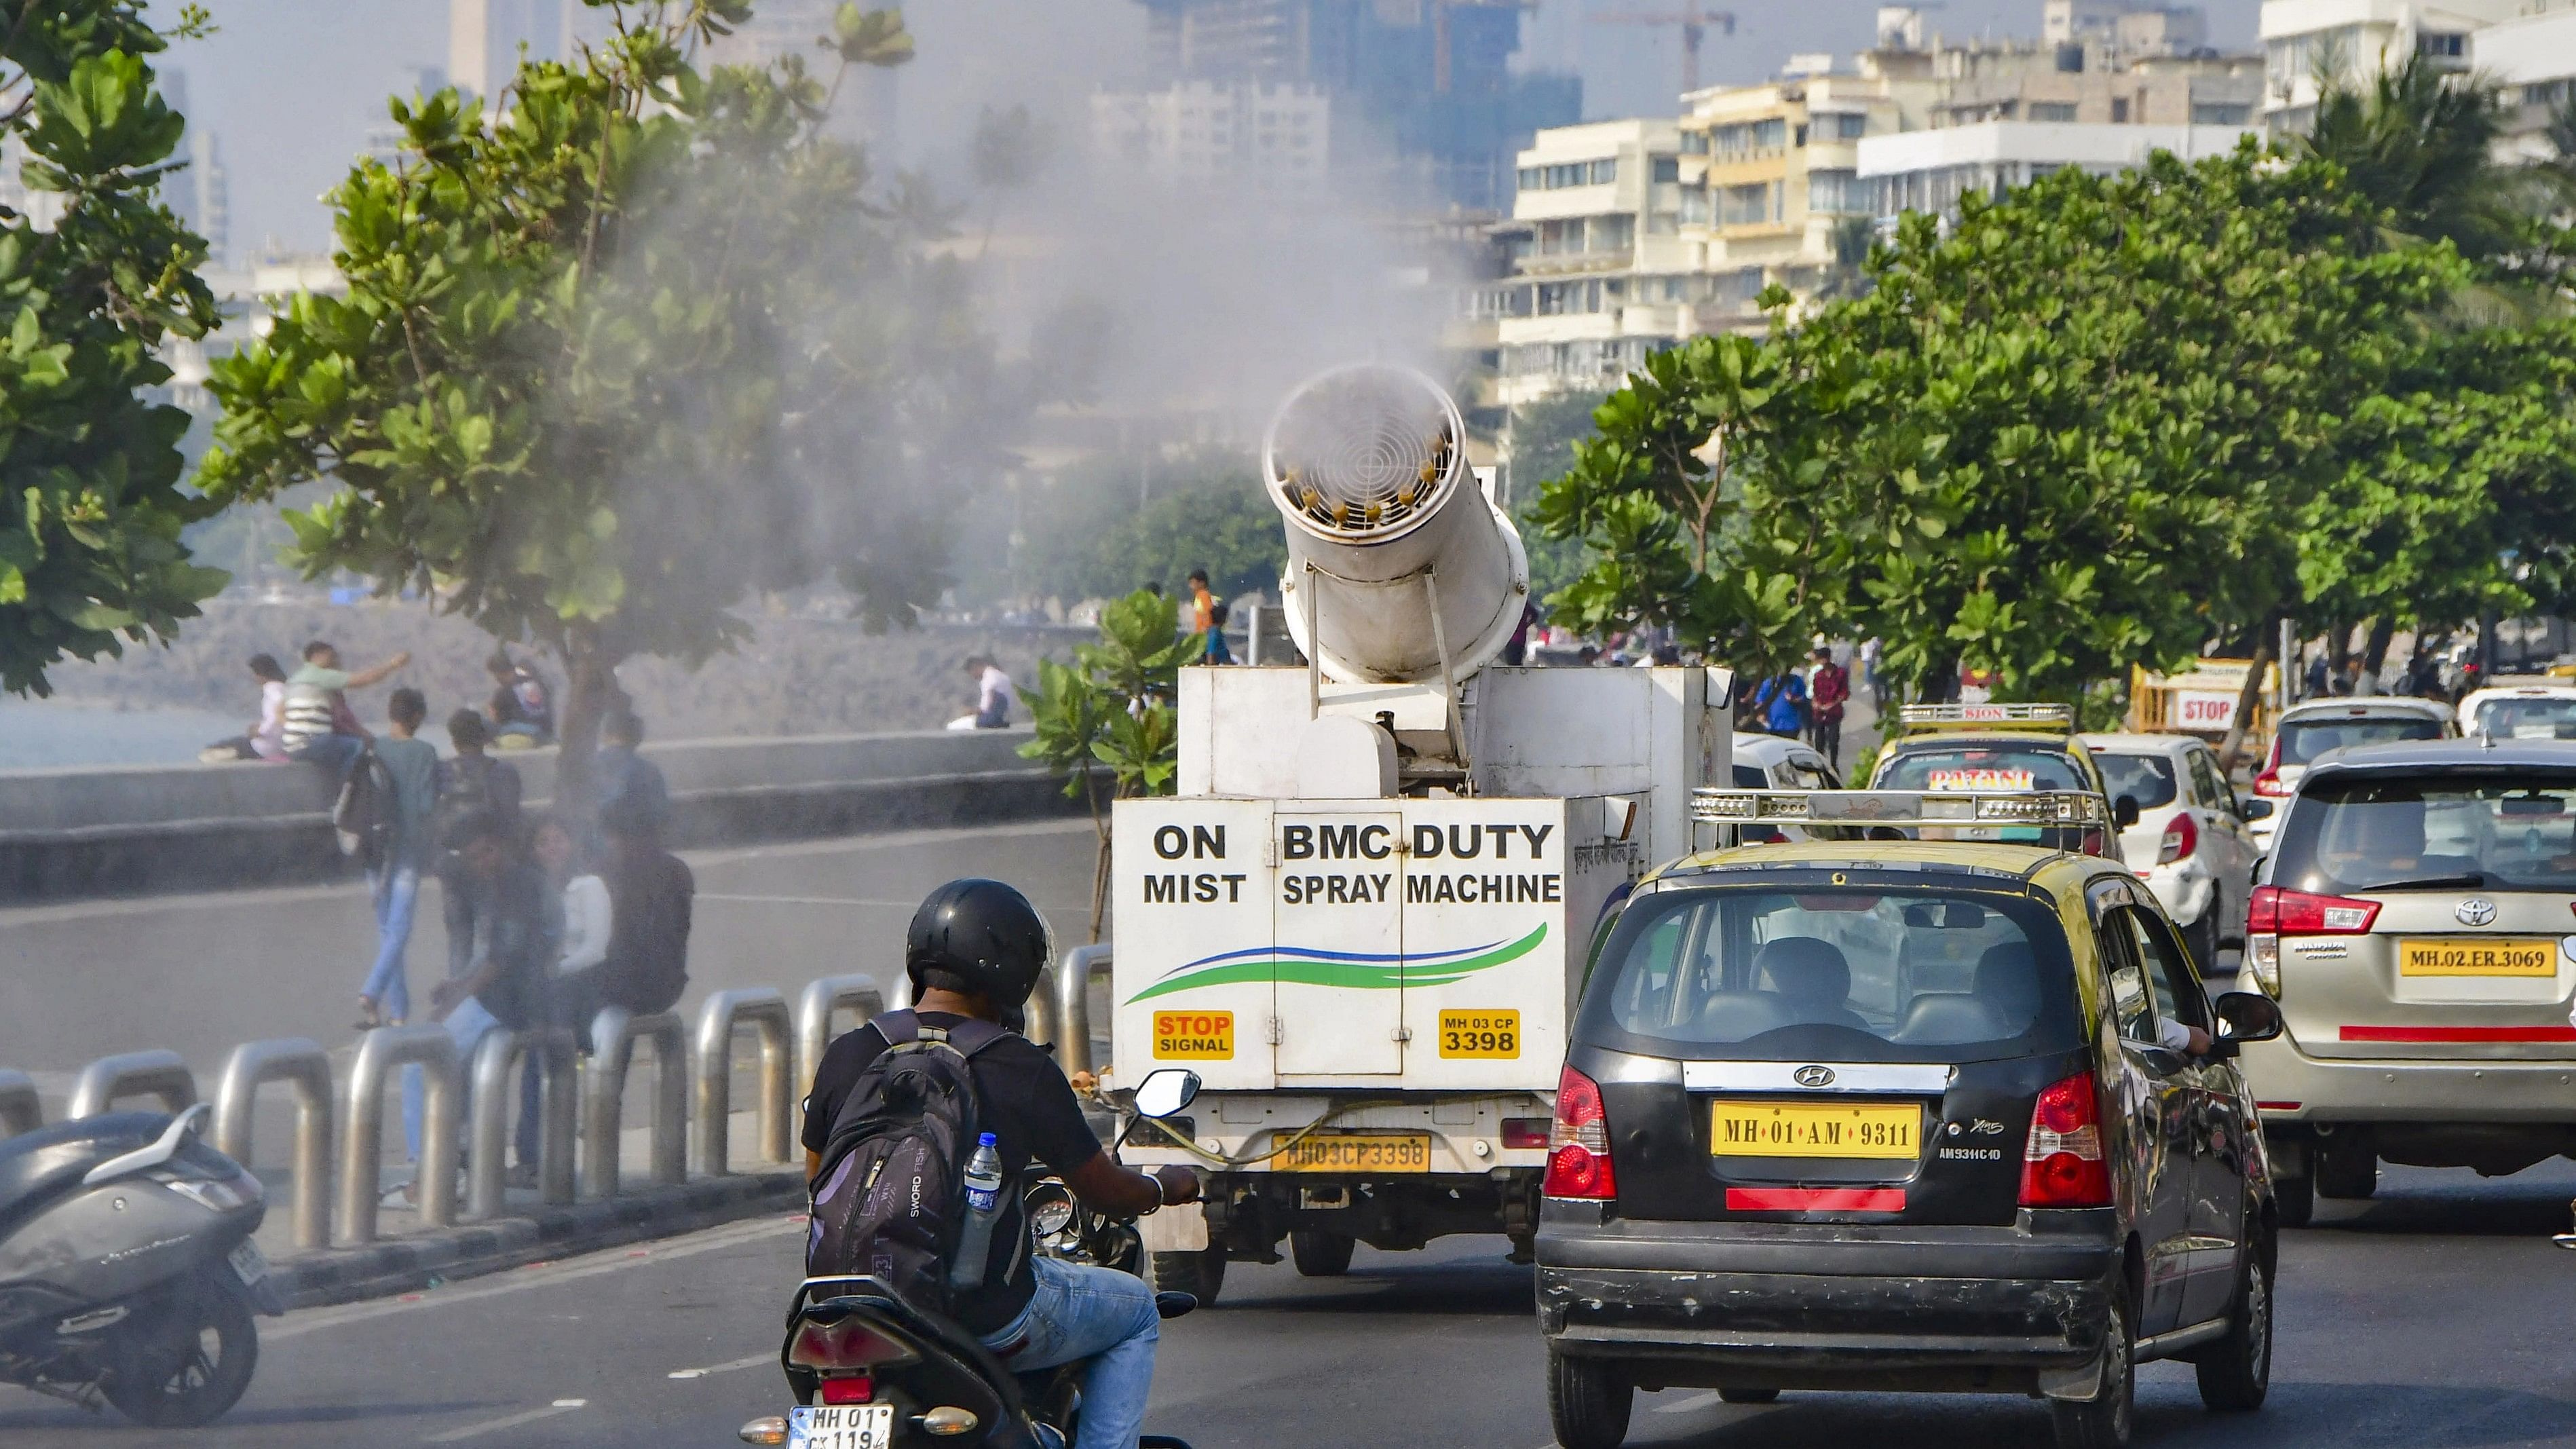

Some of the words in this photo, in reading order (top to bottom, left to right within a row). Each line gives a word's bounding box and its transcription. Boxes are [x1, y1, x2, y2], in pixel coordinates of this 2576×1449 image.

[2185, 700, 2231, 720] STOP
[1154, 825, 1226, 860] ON
[1283, 825, 1391, 860] BMC
[1414, 825, 1554, 860] DUTY
[1143, 873, 1247, 903] MIST
[1283, 873, 1392, 905] SPRAY
[1407, 874, 1561, 903] MACHINE
[1158, 1016, 1230, 1036] STOP
[1445, 1018, 1467, 1029] MH
[1473, 1018, 1489, 1029] 03
[1494, 1019, 1513, 1029] CP
[1160, 1038, 1228, 1052] SIGNAL
[1445, 1032, 1514, 1051] 3398
[1724, 1119, 1759, 1142] MH
[1770, 1121, 1793, 1144] 01
[1806, 1122, 1841, 1145] AM
[1861, 1123, 1909, 1146] 9311
[914, 1148, 925, 1173] FISH
[1288, 1142, 1424, 1165] MH03CP3398
[911, 1175, 922, 1218] SWORD
[813, 1408, 841, 1429] MH
[848, 1408, 874, 1430] 01
